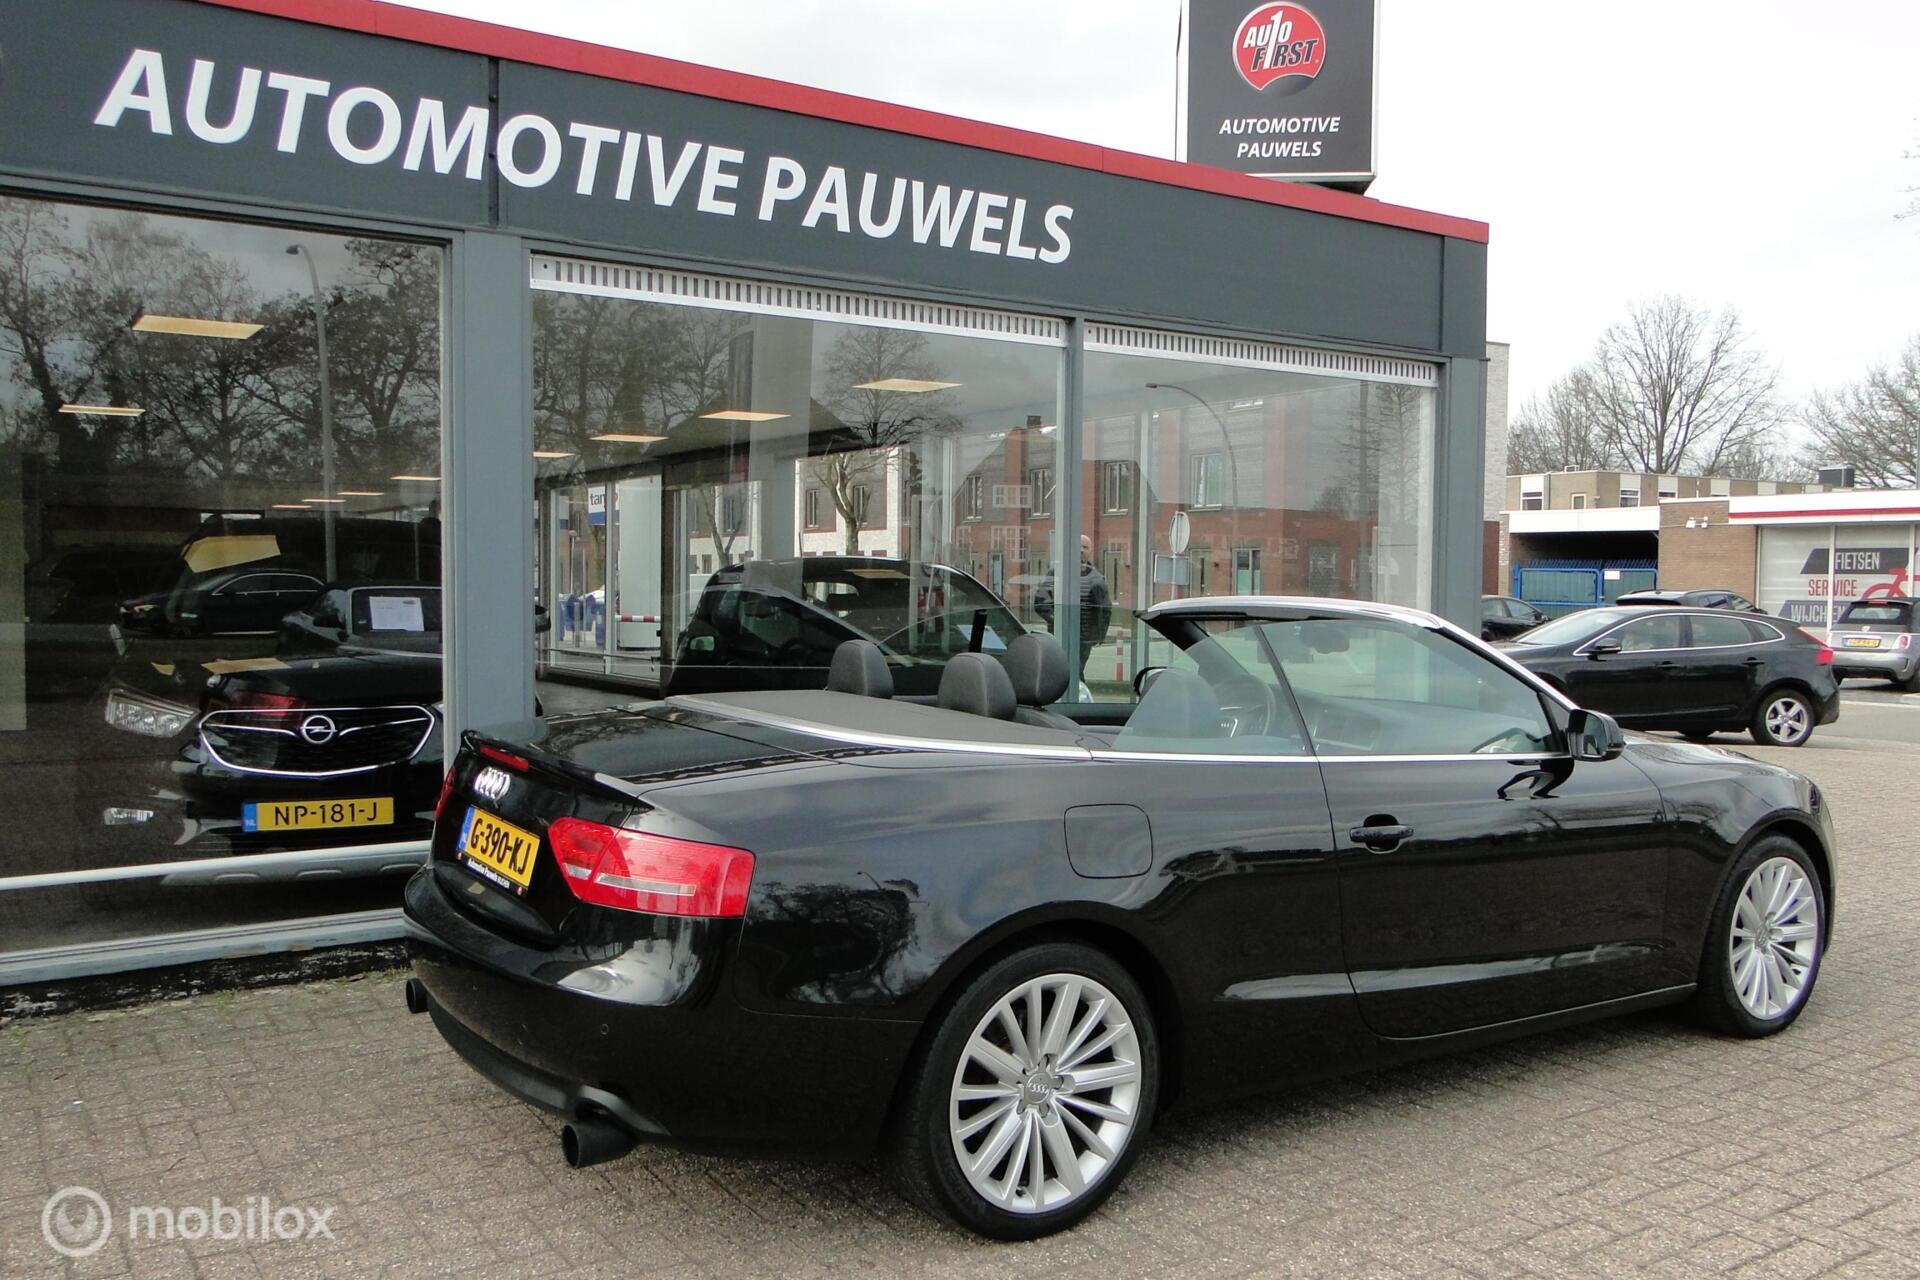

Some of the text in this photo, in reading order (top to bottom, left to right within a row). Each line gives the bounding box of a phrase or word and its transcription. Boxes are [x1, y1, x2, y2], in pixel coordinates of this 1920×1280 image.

[1219, 116, 1341, 135] AUTOMOTIVE
[94, 48, 1075, 266] AUTOMOTIVE PAUWELS
[1237, 141, 1322, 158] PAUWELS
[1834, 551, 1880, 570] FIETSEN
[1808, 579, 1857, 596] SERVICE
[274, 801, 377, 826] NP-181-J
[470, 817, 532, 876] G-390-KJ
